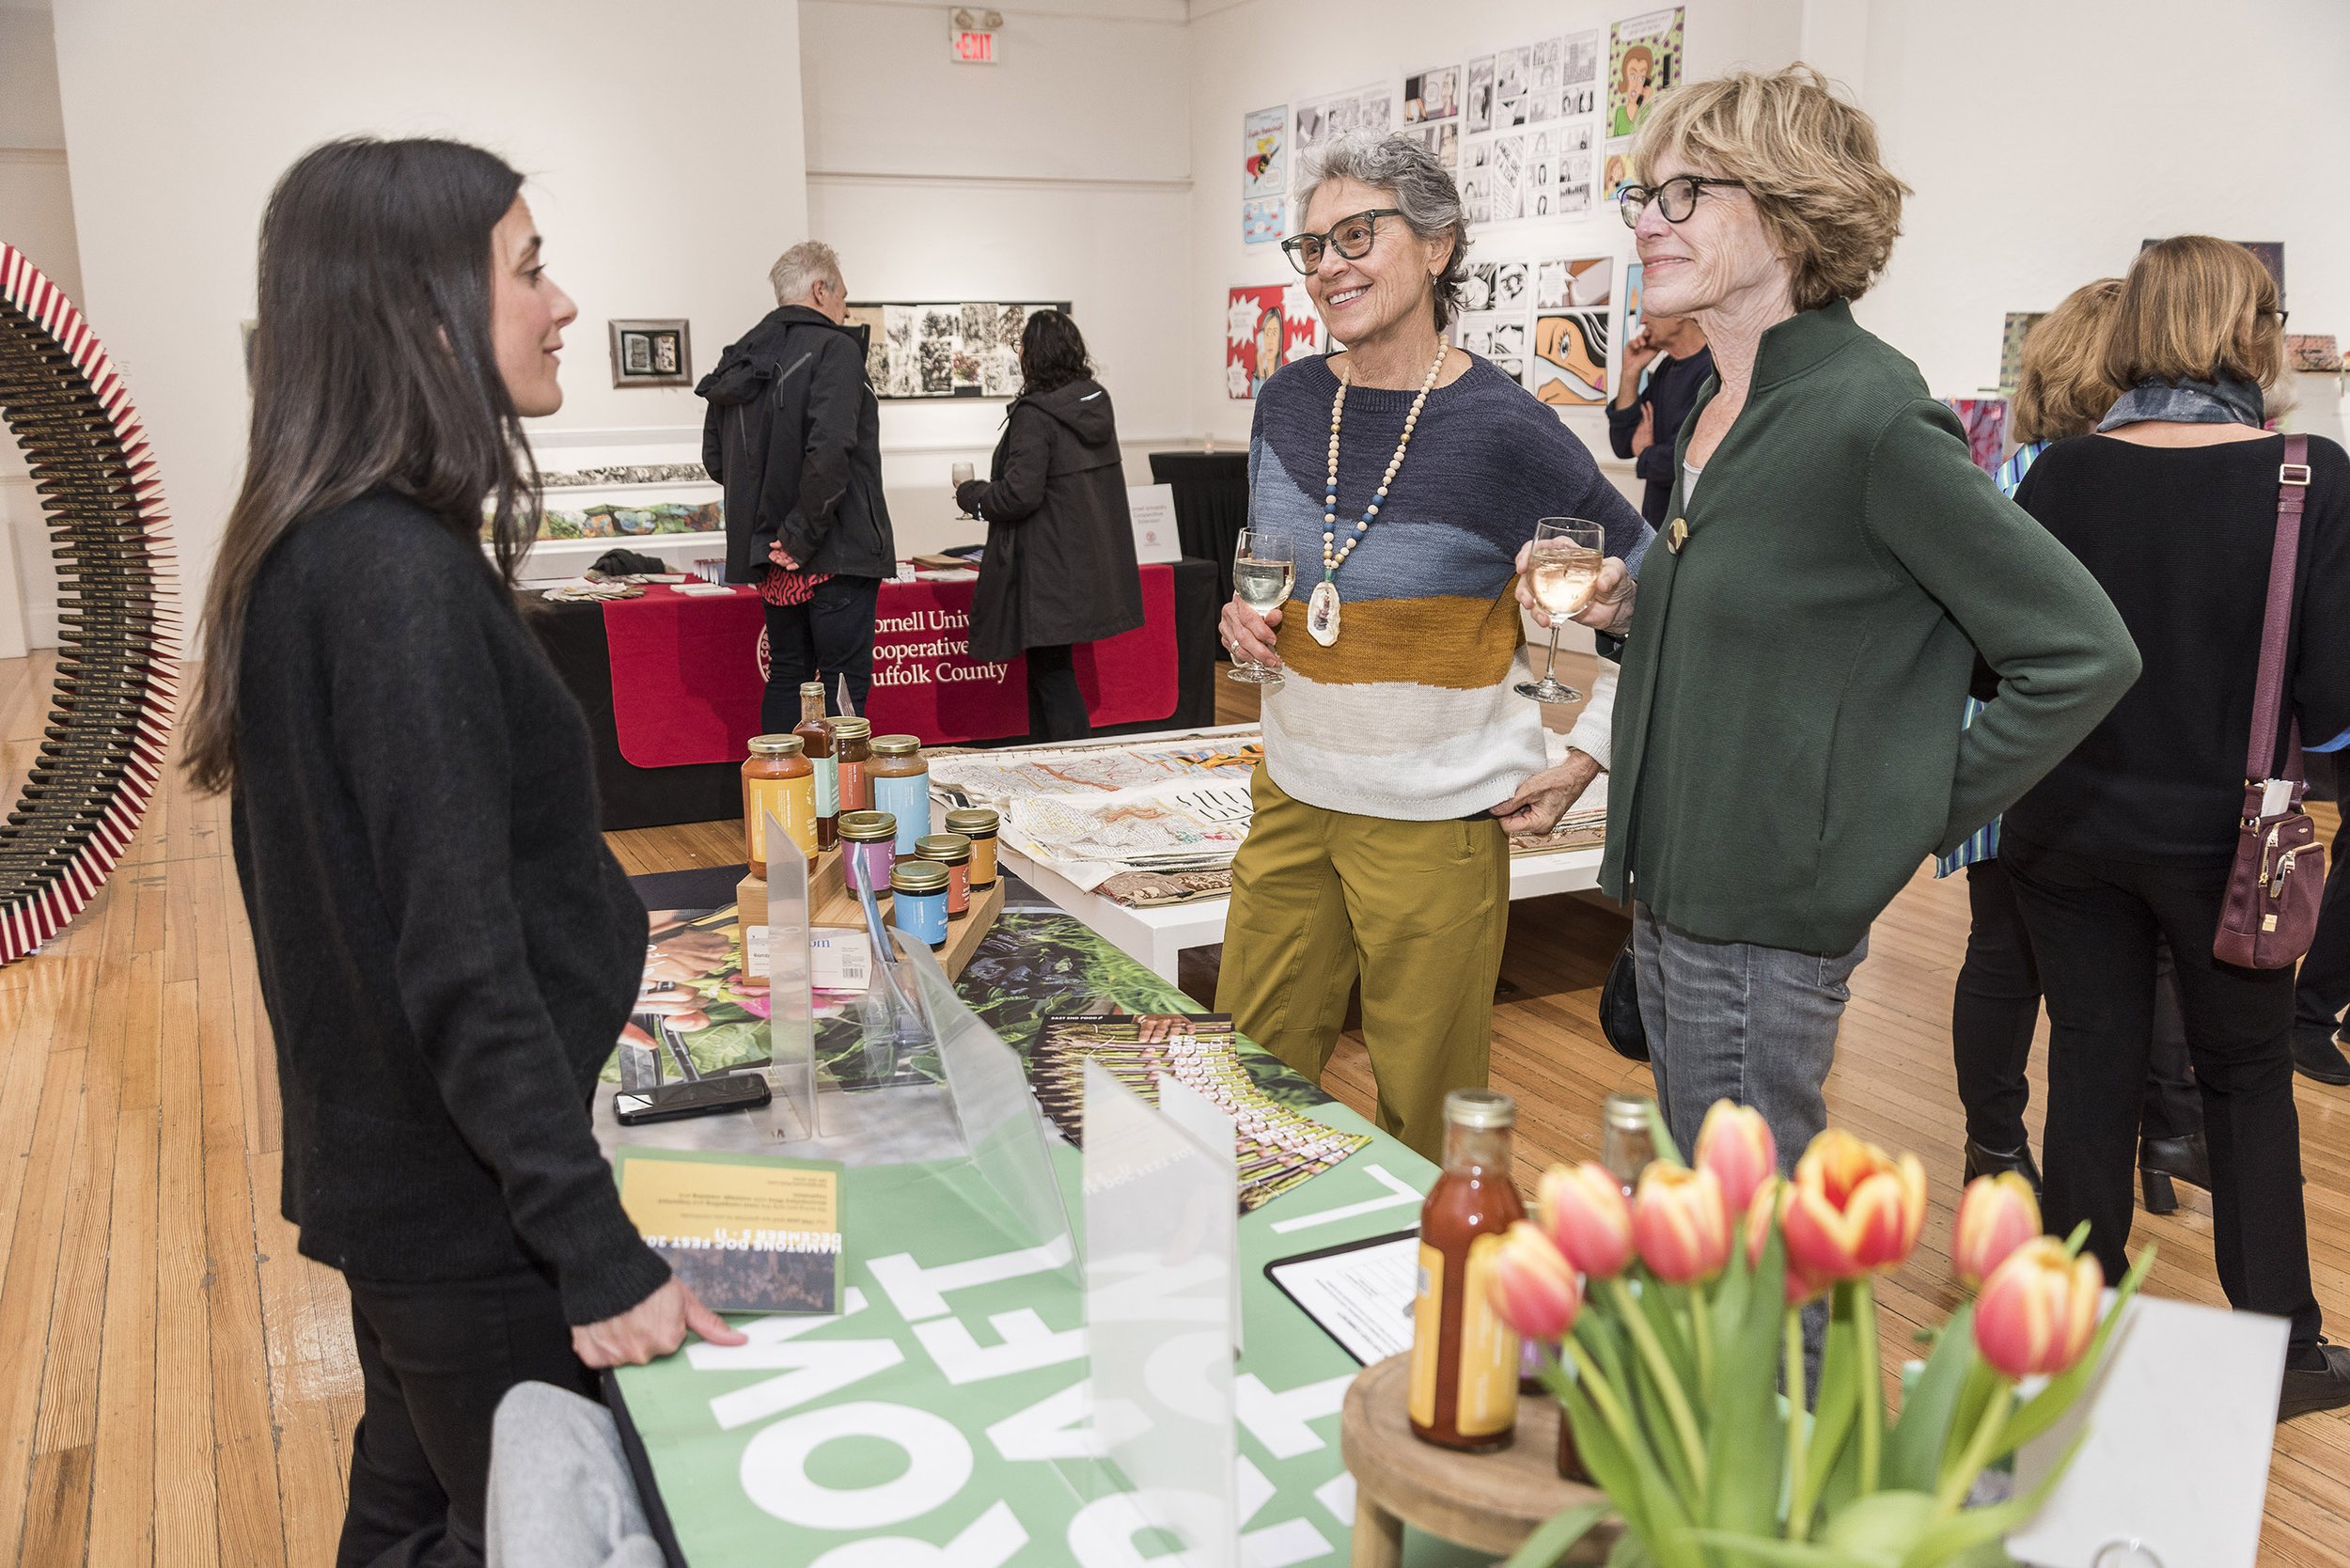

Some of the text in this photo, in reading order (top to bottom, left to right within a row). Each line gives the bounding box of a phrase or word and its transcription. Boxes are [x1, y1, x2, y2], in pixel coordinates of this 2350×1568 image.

[962, 32, 993, 61] EXIT
[875, 609, 969, 633] ornell Univ
[872, 637, 969, 664] ooperative
[871, 662, 1008, 686] uffolk County
[643, 1234, 842, 1254] HAMPTONS DOC FEST 20
[756, 1229, 842, 1243] DECEMBER
[686, 1287, 1028, 1568] ROW
